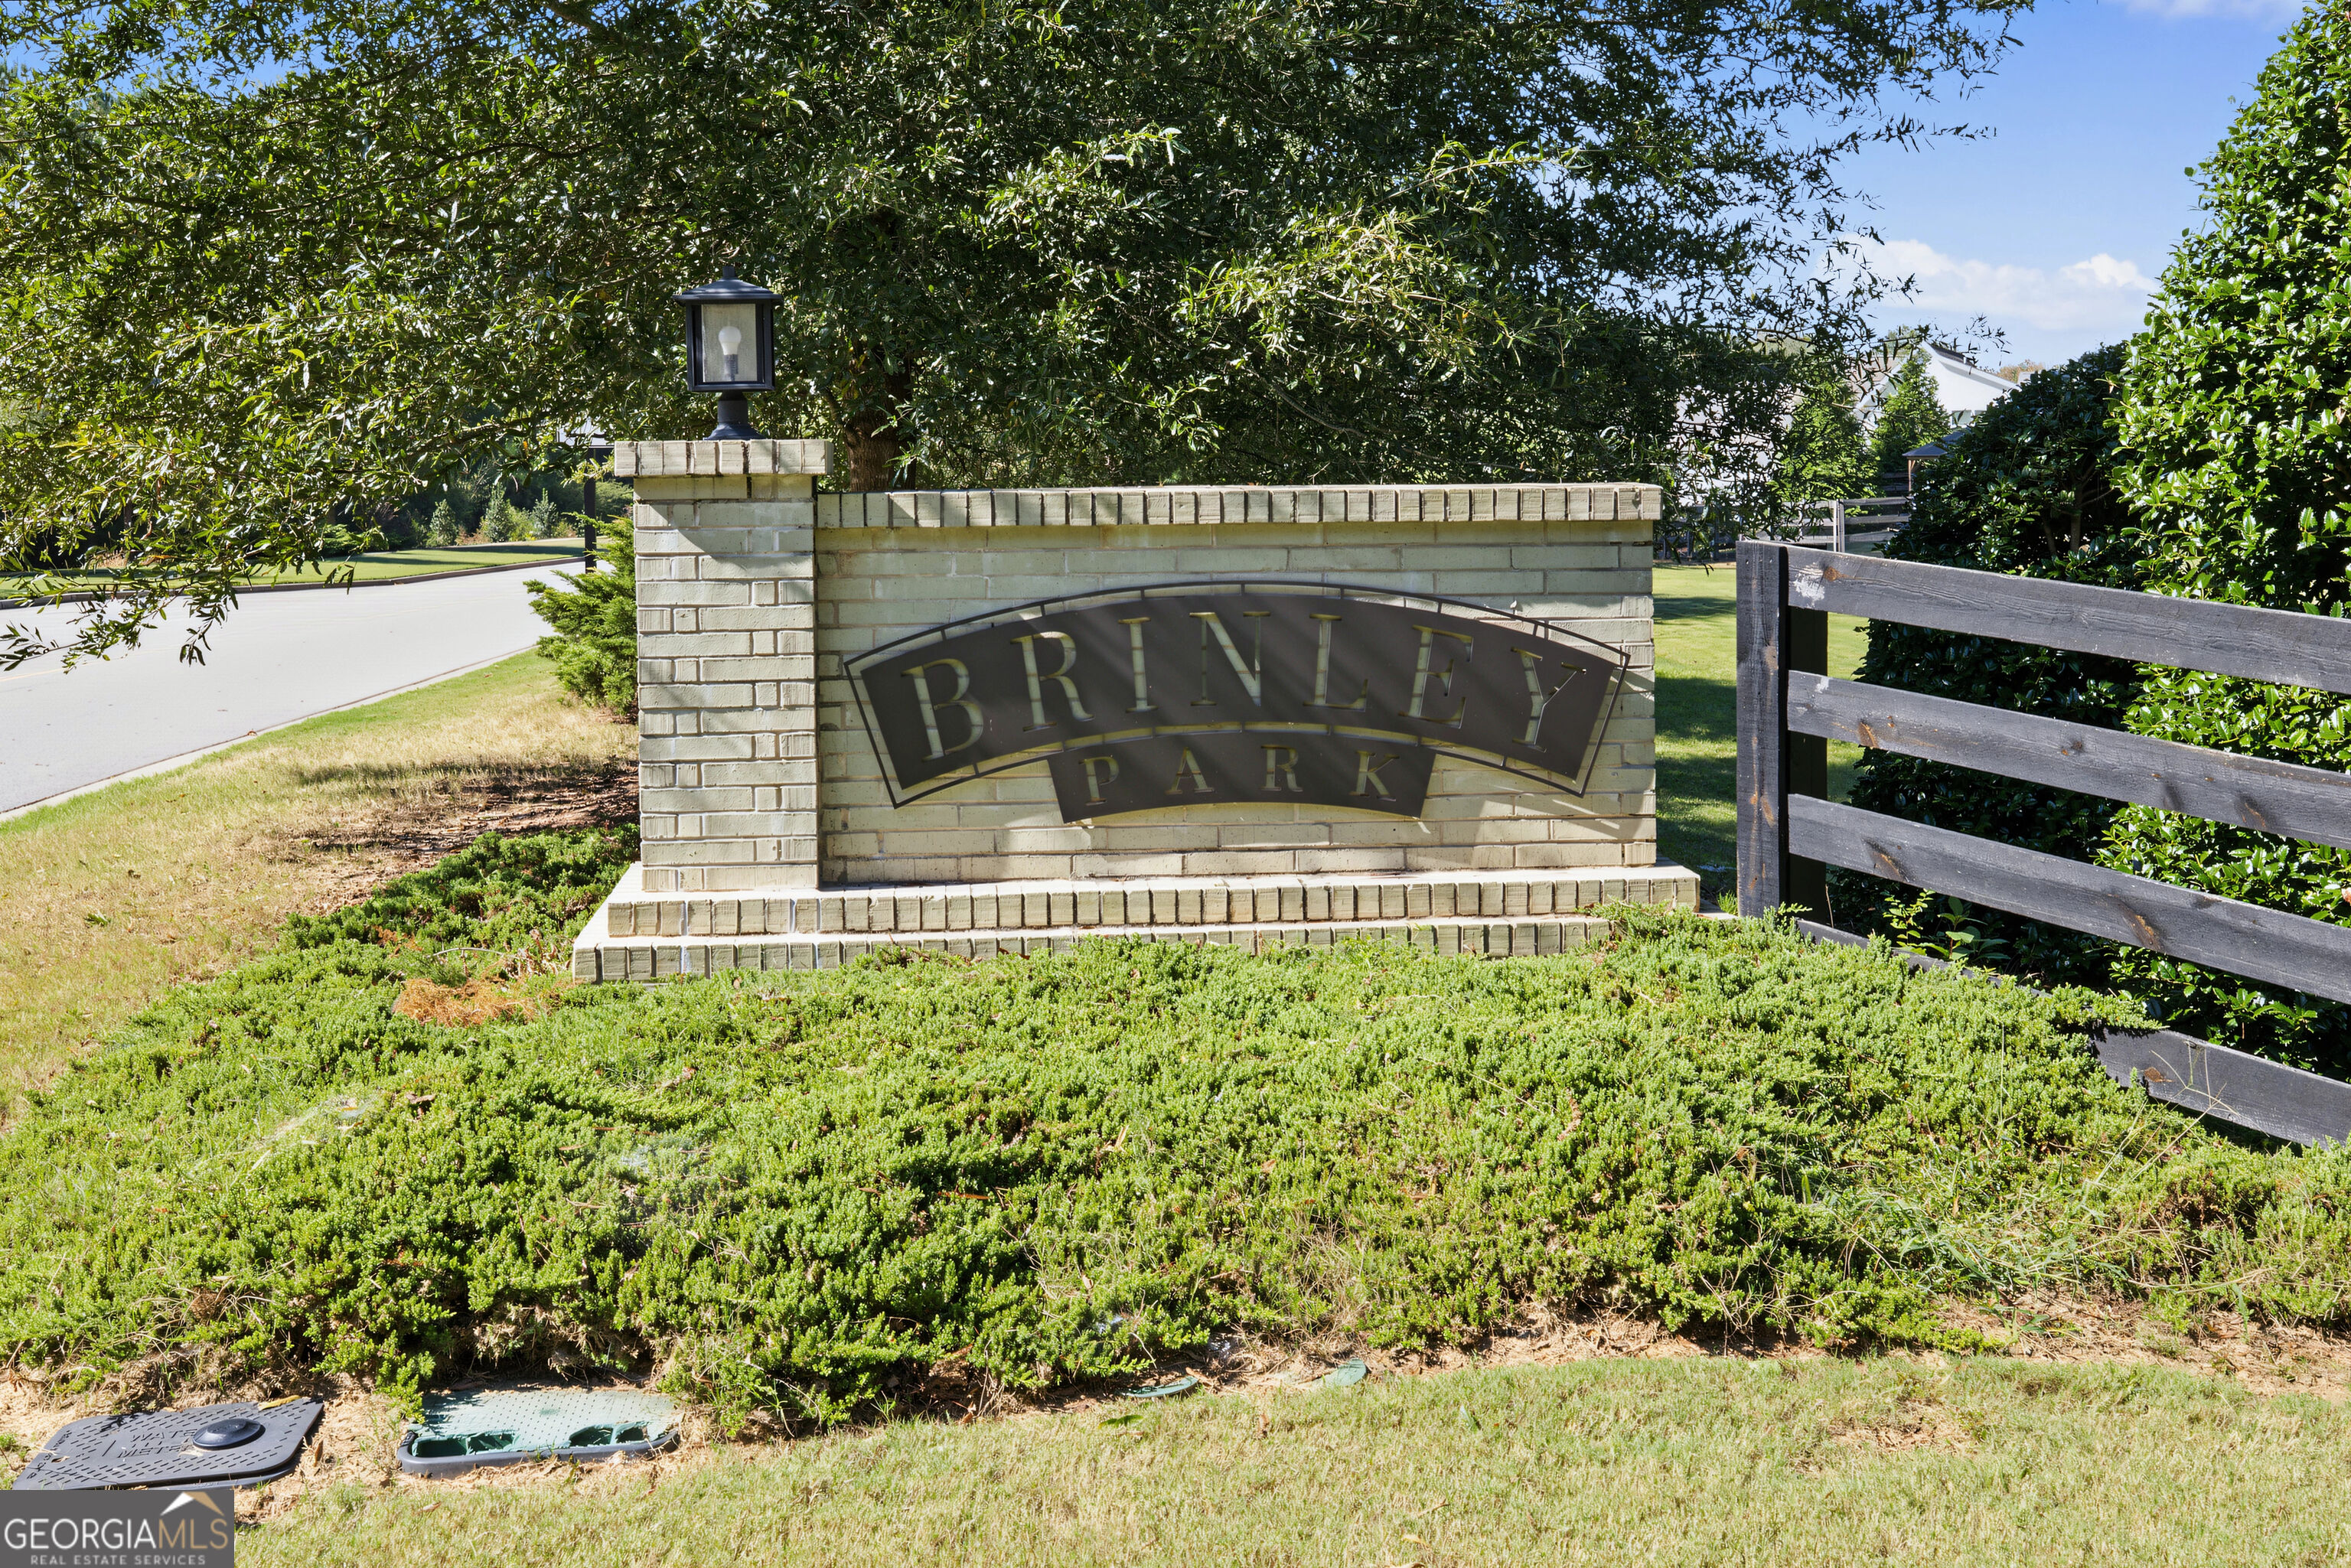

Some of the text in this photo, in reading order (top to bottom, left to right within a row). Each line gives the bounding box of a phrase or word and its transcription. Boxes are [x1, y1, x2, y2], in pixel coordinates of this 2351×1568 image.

[900, 610, 1588, 763] BRINLEY
[1077, 743, 1402, 807] PARK
[118, 1443, 188, 1459] METE
[131, 1428, 197, 1443] WATE
